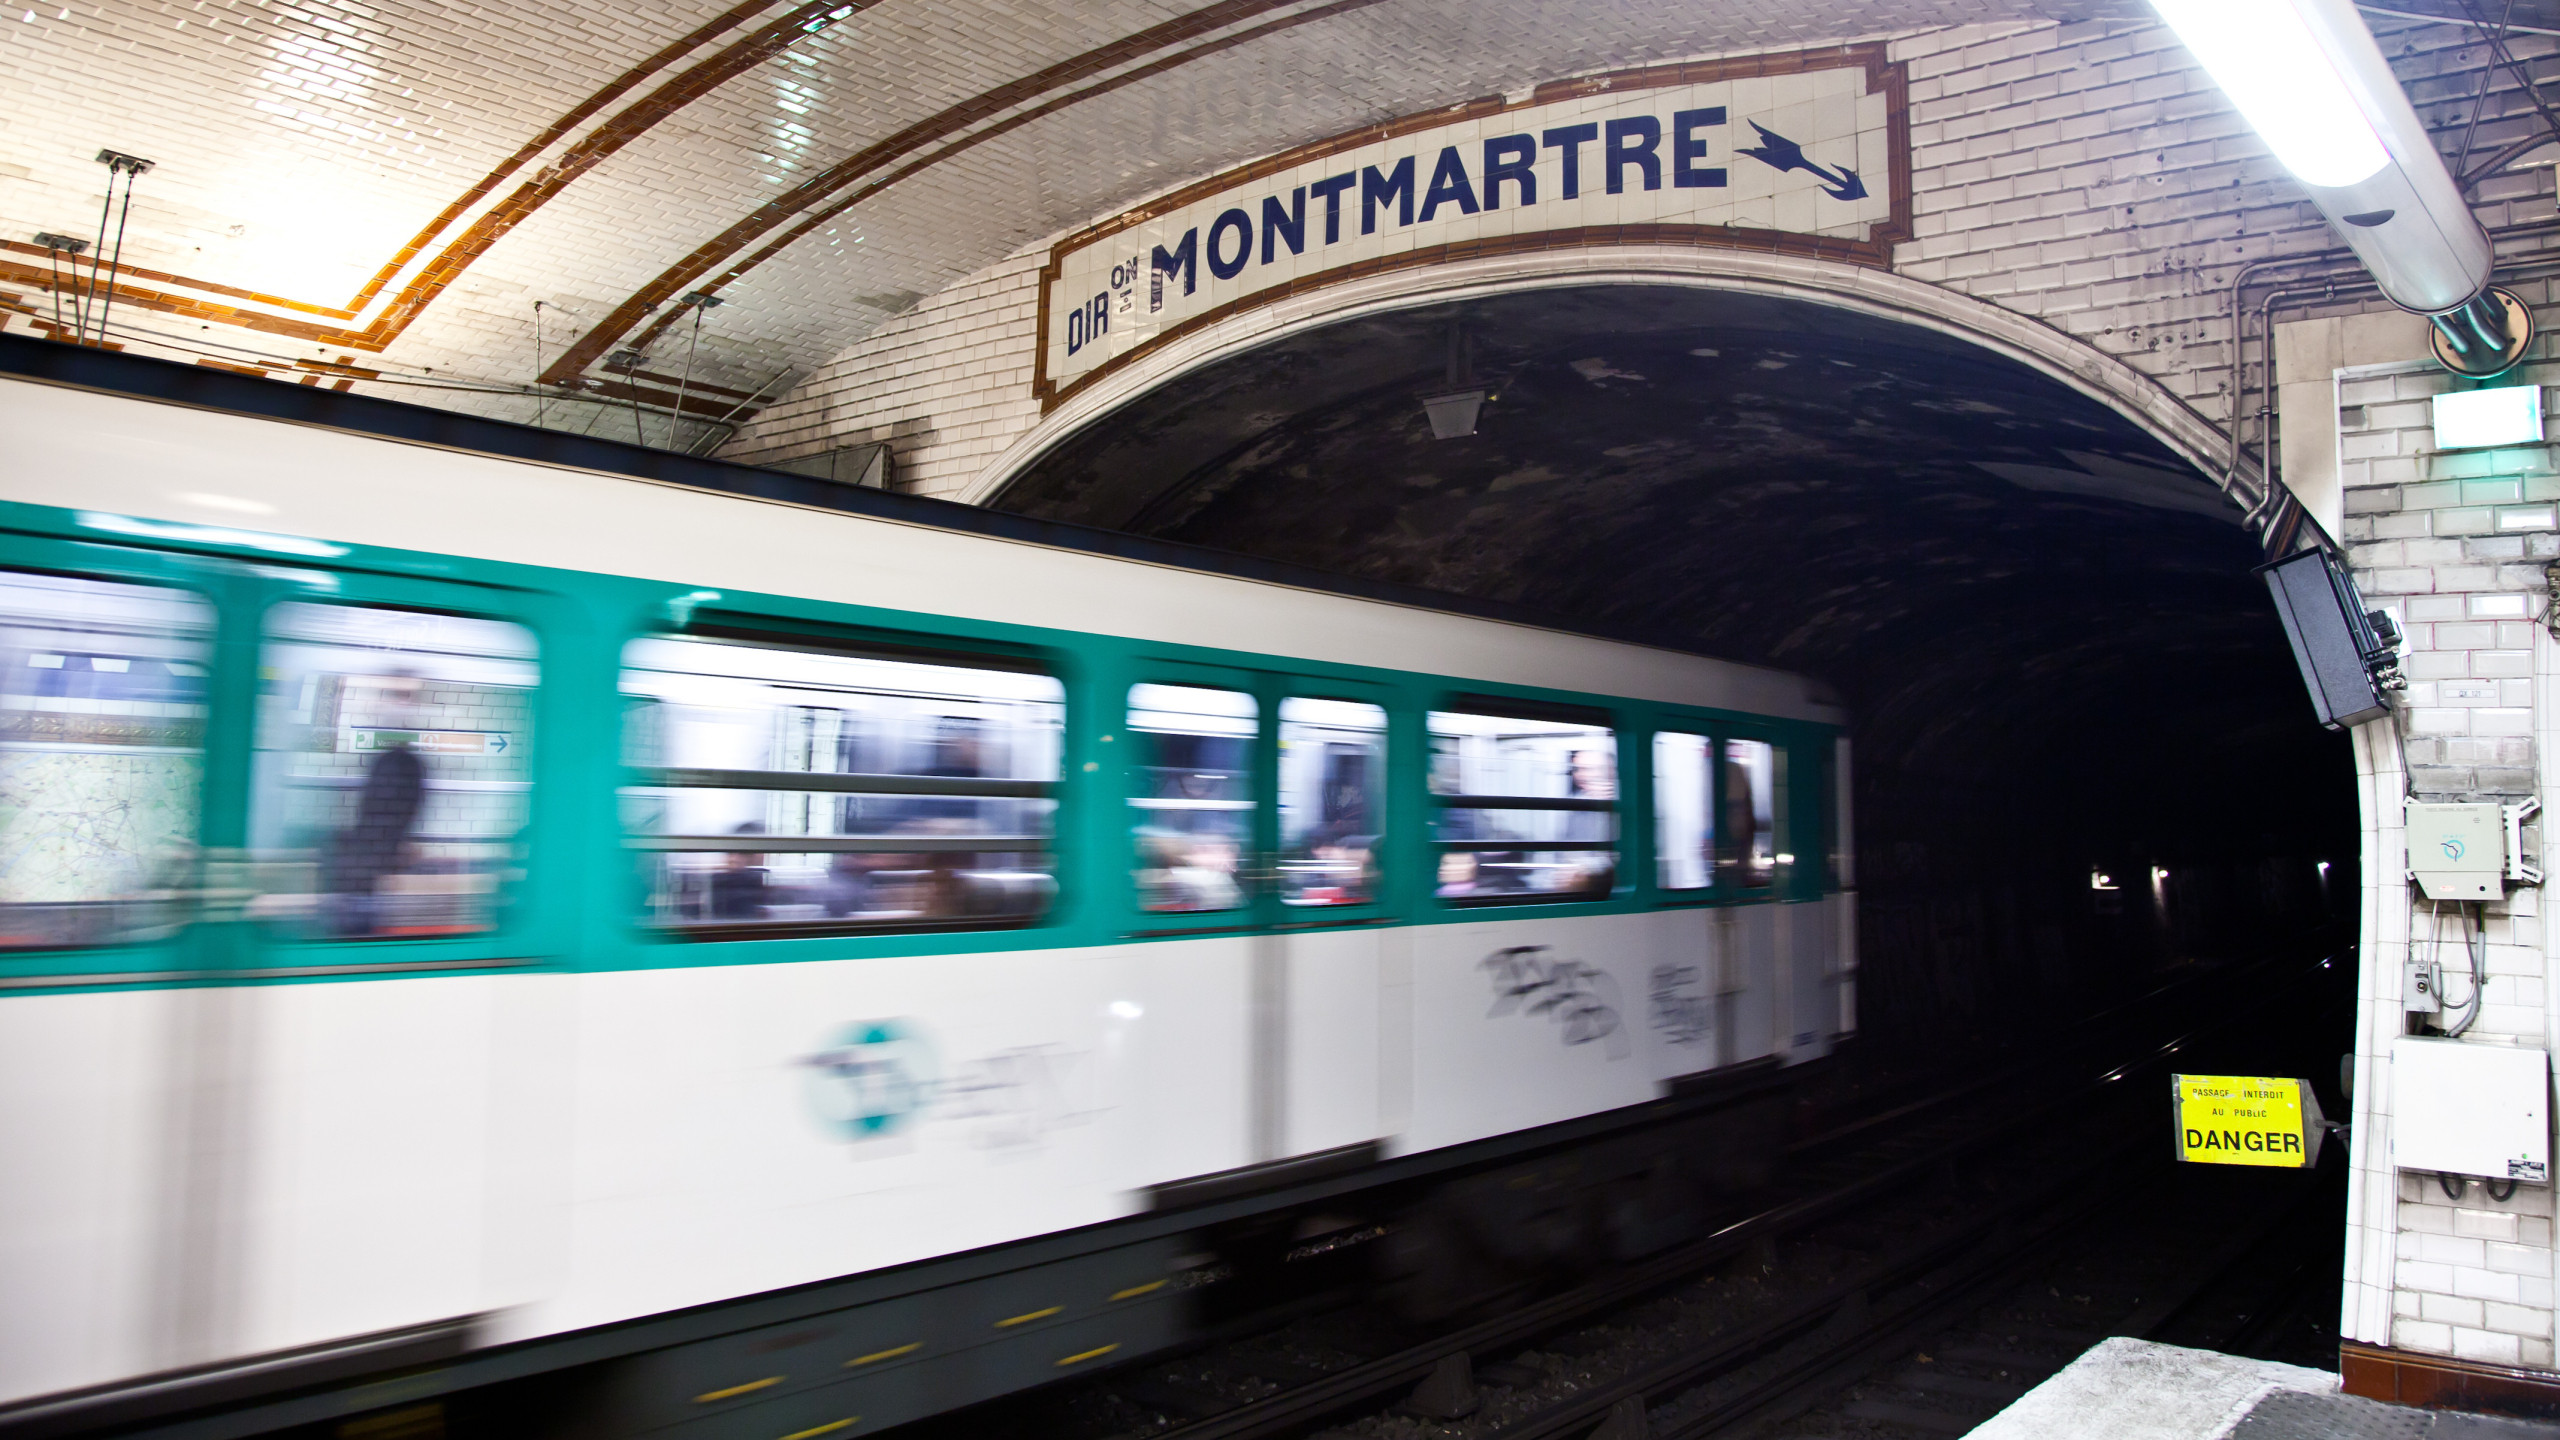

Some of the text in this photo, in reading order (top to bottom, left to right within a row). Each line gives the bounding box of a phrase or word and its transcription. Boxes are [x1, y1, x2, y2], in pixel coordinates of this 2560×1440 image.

[1150, 106, 1728, 314] MONTMARTRE
[2192, 1088, 2284, 1099] PASSAGE INTERDIT
[2212, 1108, 2267, 1118] AU PUBLIC
[2186, 1128, 2300, 1153] DANGER
